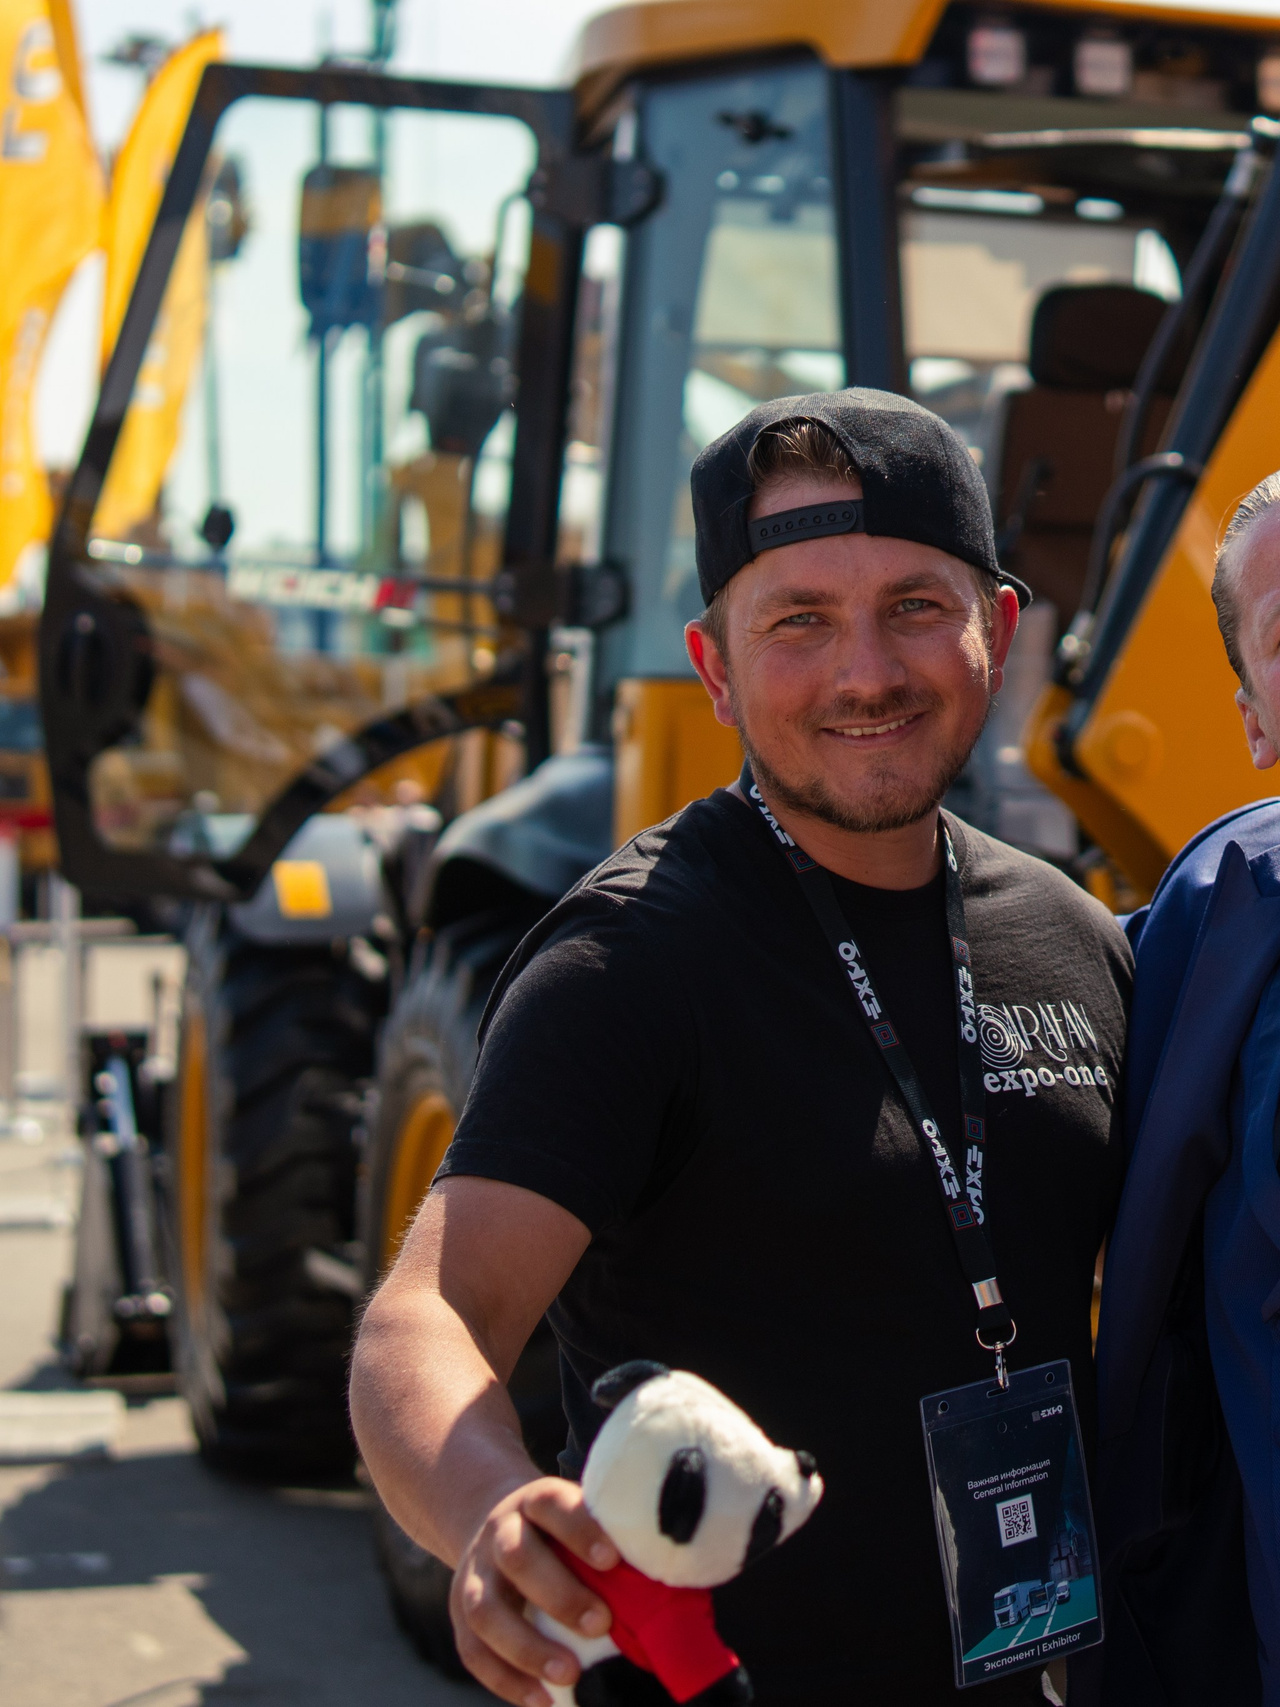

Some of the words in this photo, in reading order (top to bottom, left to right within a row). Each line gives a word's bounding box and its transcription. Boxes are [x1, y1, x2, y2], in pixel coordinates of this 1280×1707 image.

[838, 940, 881, 1020] EXPO
[958, 966, 978, 1043] EXPO
[983, 1065, 1108, 1097] expo-one
[922, 1118, 961, 1199] EXPO
[1040, 1404, 1063, 1418] EXPO
[967, 1474, 999, 1490] Важная
[1000, 1459, 1051, 1479] информация
[973, 1484, 1004, 1500] General
[1004, 1472, 1049, 1491] Information
[983, 1648, 1036, 1672] Экспонент
[1042, 1632, 1081, 1652] Exhibitor
